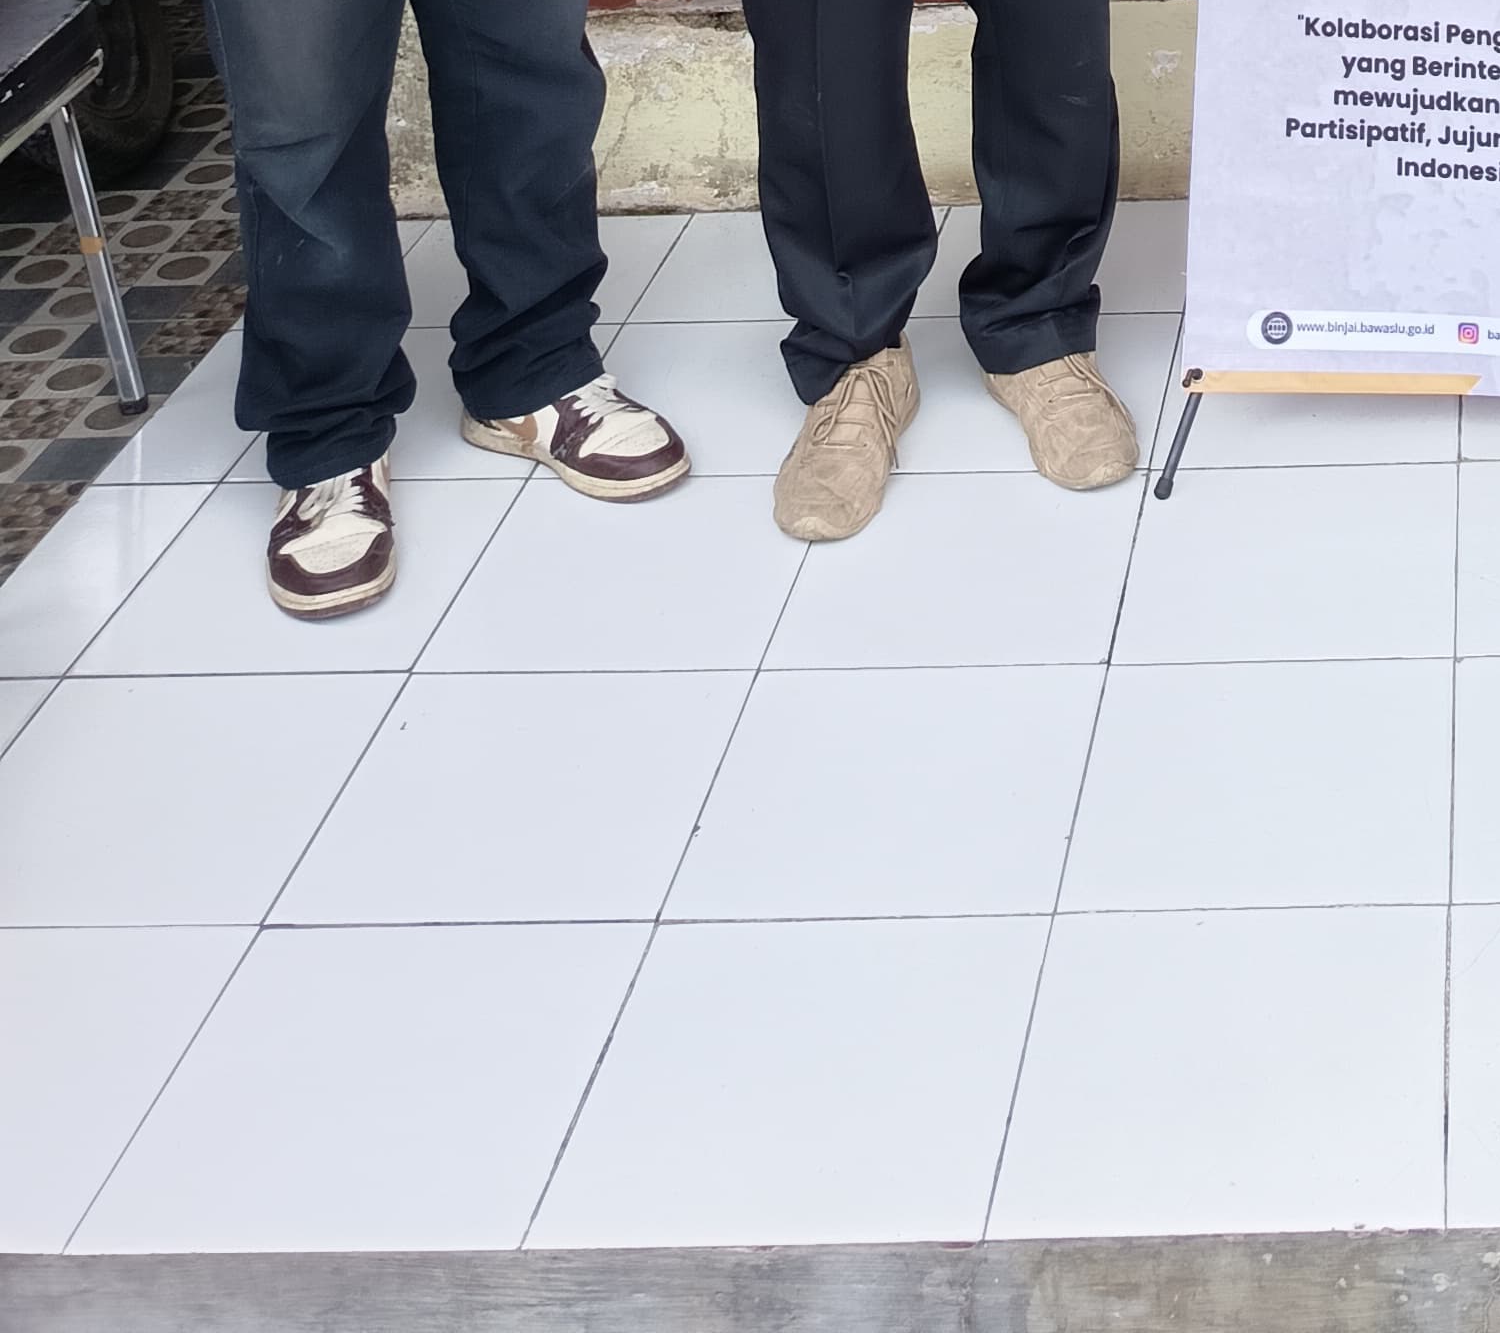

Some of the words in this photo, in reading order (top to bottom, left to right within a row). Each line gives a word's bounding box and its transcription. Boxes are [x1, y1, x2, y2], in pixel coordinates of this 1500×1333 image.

[1298, 15, 1440, 43] "Kolaborasi
[1342, 54, 1406, 80] yang
[1333, 87, 1500, 116] mewujudkan
[1285, 117, 1432, 148] Partisipatif,
